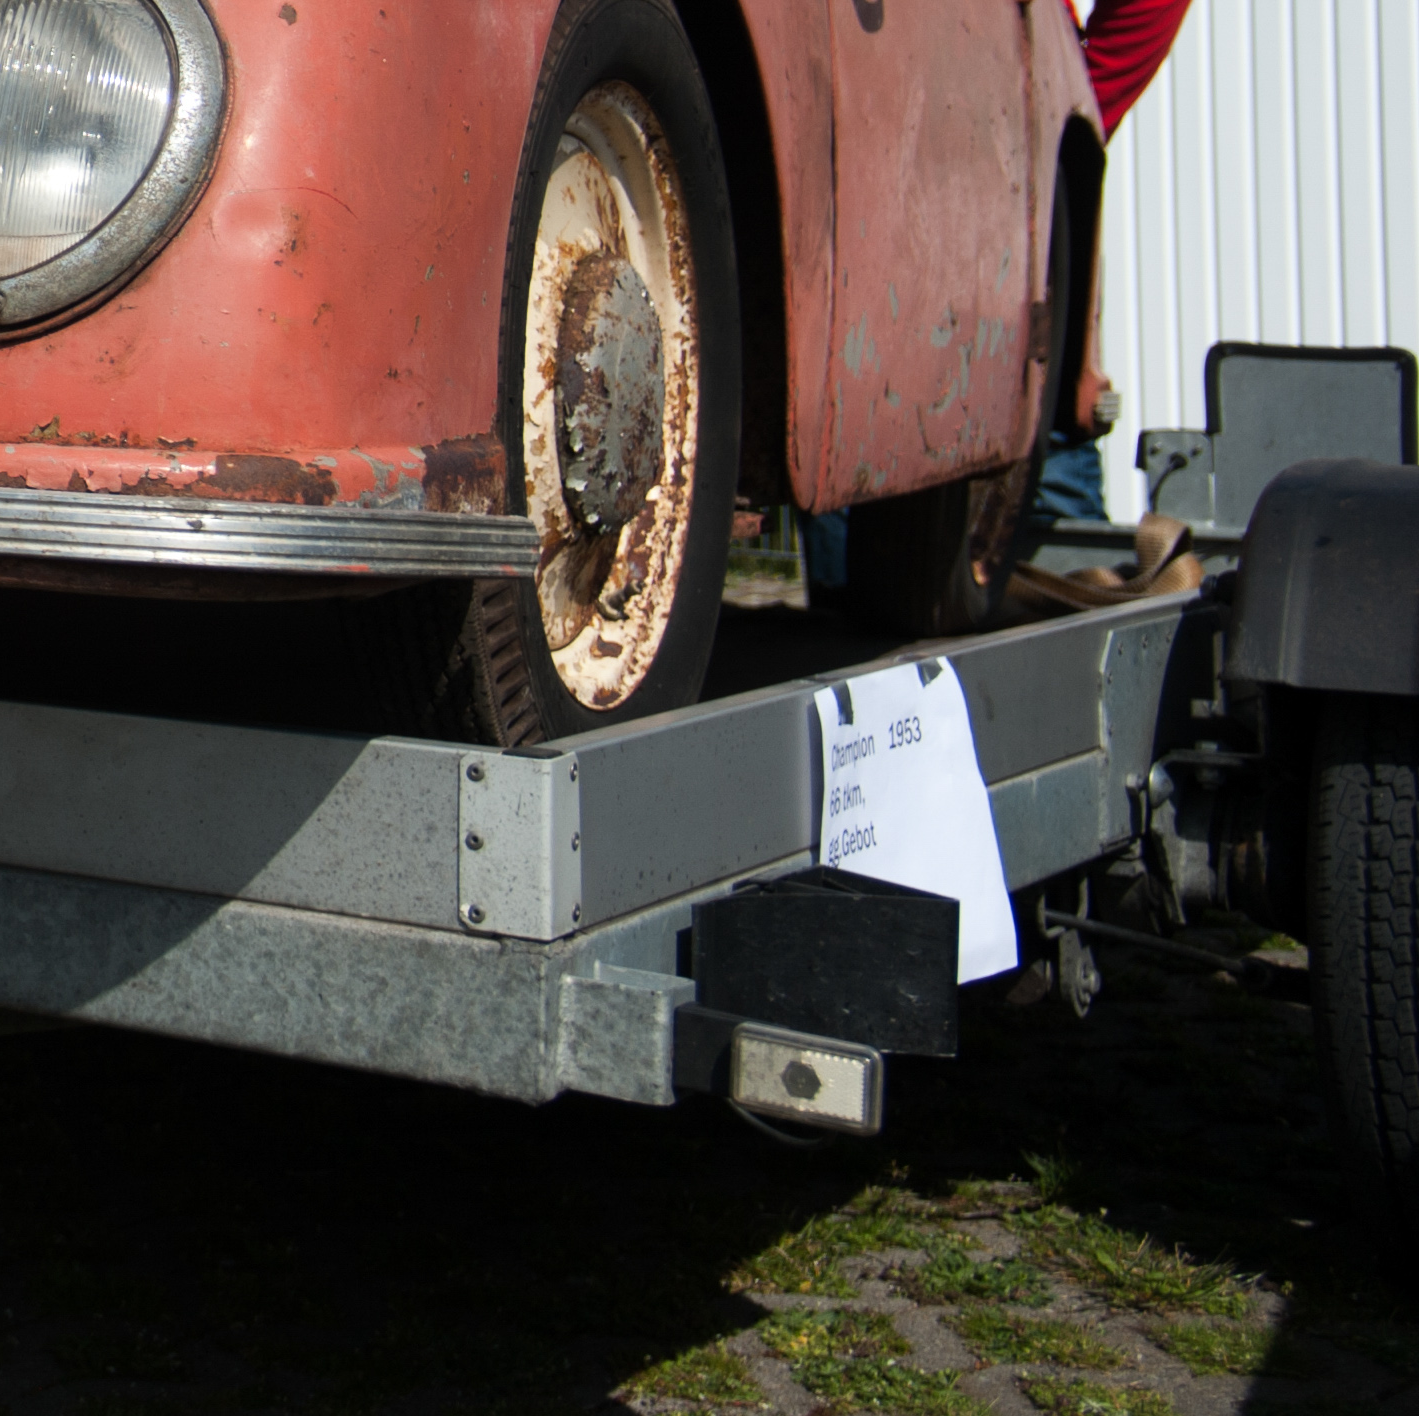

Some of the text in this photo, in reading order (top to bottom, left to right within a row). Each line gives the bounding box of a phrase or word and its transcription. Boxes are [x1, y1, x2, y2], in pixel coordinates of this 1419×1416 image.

[830, 716, 923, 772] Champion 1953
[829, 782, 867, 818] 66 tkm,
[827, 821, 878, 869] gg.Gebot
